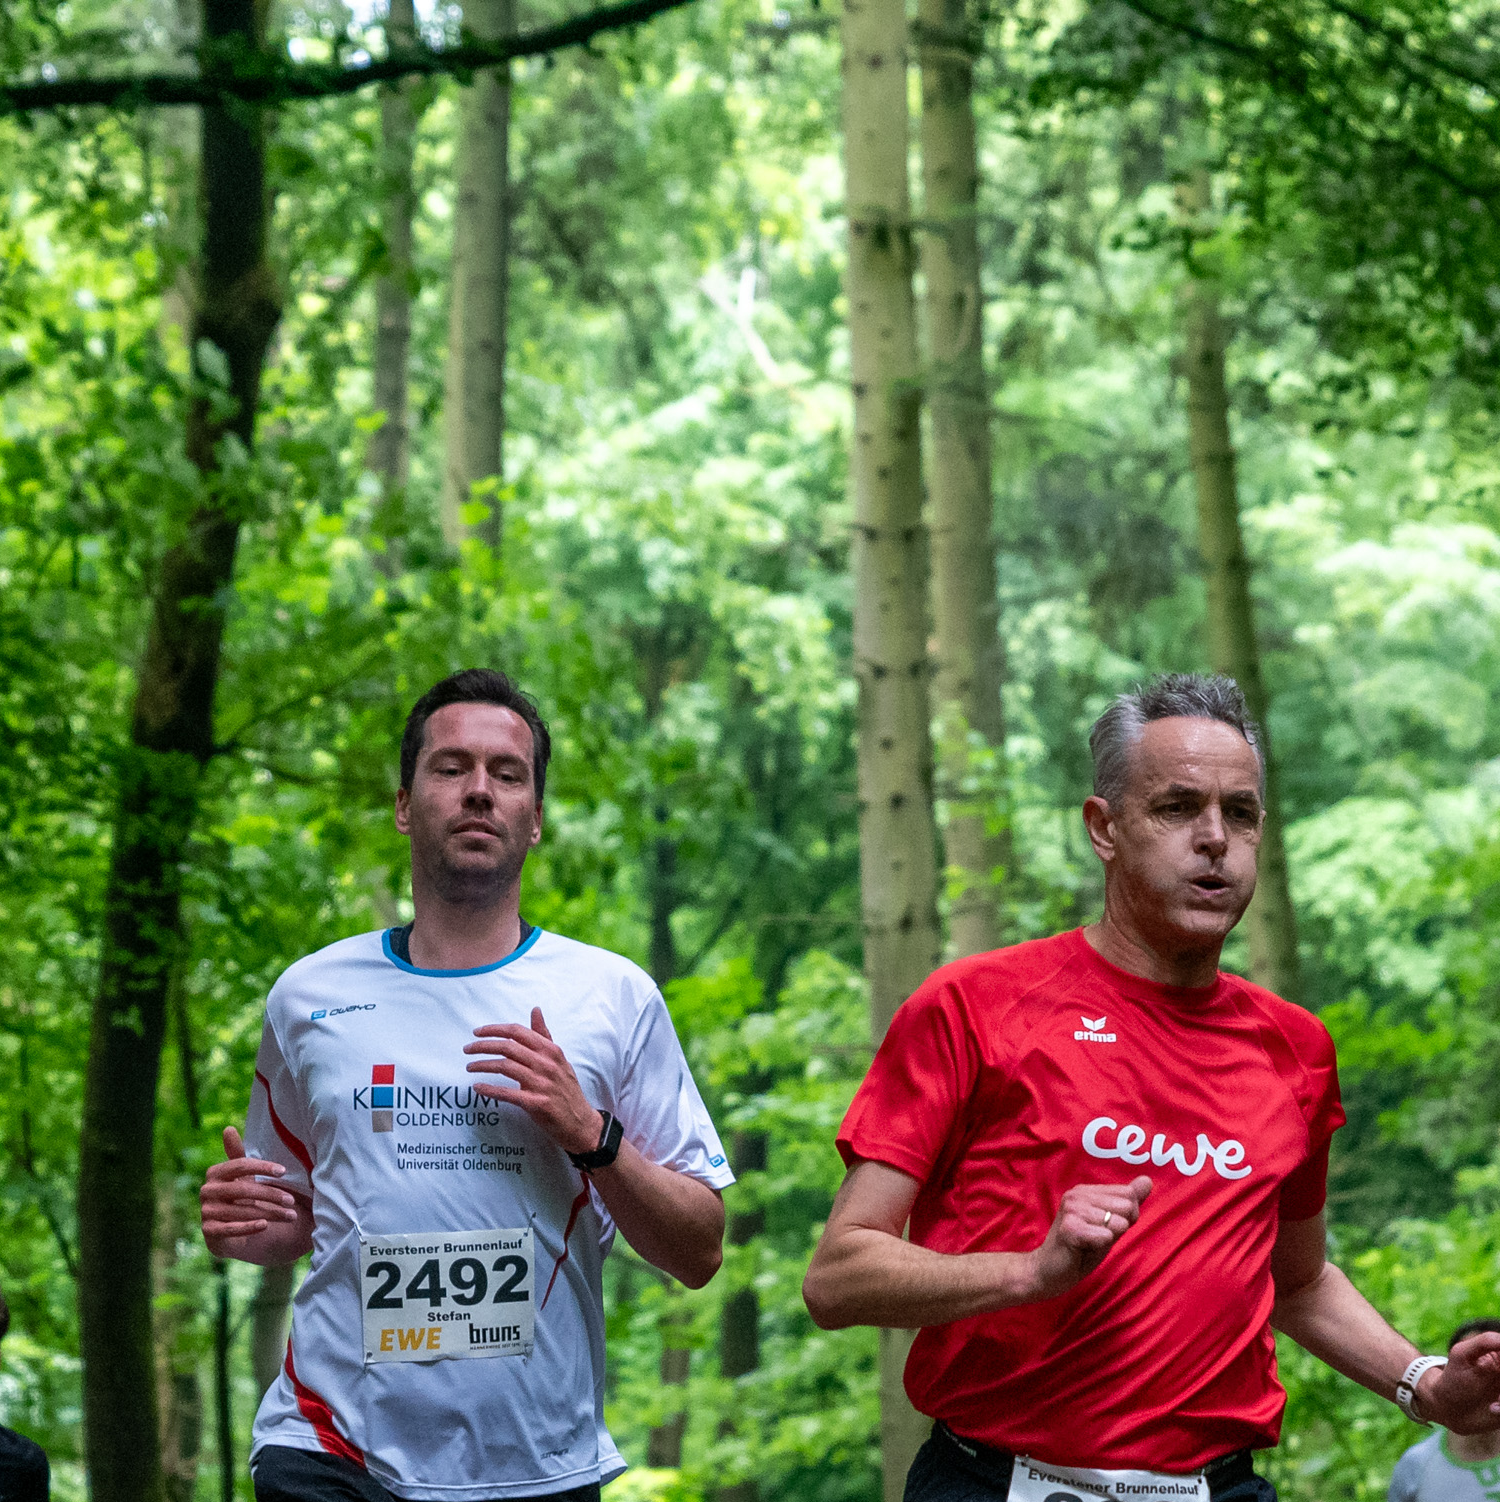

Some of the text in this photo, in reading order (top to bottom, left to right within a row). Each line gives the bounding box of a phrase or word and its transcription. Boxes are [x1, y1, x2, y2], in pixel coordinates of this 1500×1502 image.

[1074, 1030, 1117, 1043] erima
[396, 1112, 500, 1127] OLDENBURG
[397, 1143, 525, 1156] Medizinischer Campus
[1082, 1116, 1252, 1180] cewe
[397, 1158, 522, 1174] Universität Oldenburg
[370, 1238, 523, 1256] Everstener Brunnenlauf
[365, 1254, 530, 1310] 2492
[427, 1310, 471, 1322] Stefan
[380, 1327, 442, 1352] EWE
[469, 1323, 520, 1344] bruns
[1028, 1469, 1199, 1495] Everstener Brunnenlauf
